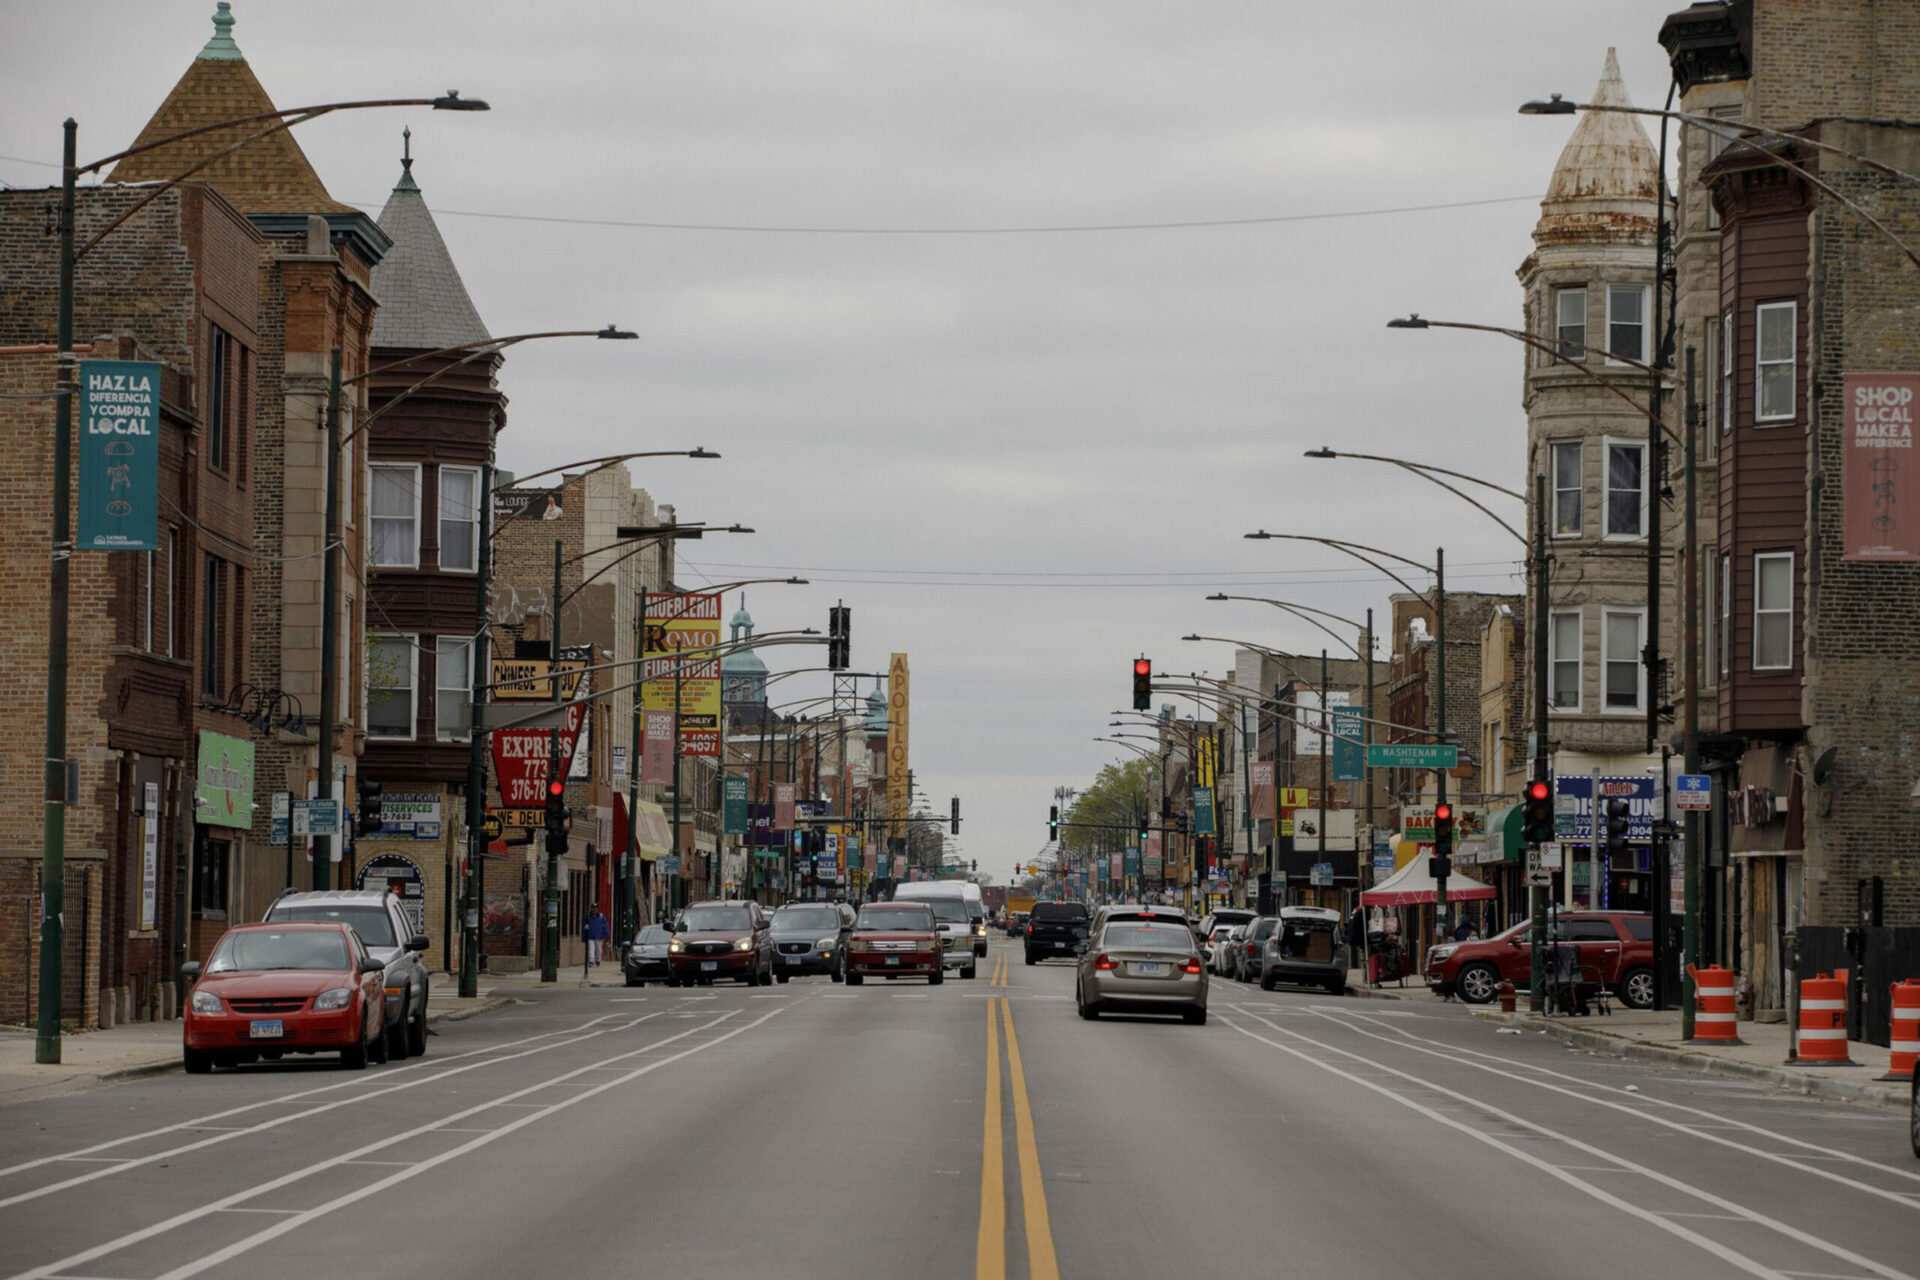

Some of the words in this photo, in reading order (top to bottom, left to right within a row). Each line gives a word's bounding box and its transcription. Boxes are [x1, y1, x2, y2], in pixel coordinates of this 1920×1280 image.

[89, 375, 125, 391] HAZ
[129, 376, 151, 391] LA
[89, 392, 151, 404] DIFERENCIA
[1855, 386, 1912, 406] SHOP
[90, 405, 98, 415] Y
[99, 405, 151, 417] COMPRA
[1855, 407, 1912, 422] LOCAL
[88, 417, 151, 435] LOCAL
[1856, 424, 1899, 437] MAKE
[1901, 424, 1912, 437] A
[1855, 438, 1912, 448] DIFFERENCE
[644, 597, 718, 619] MUEBLERIA
[643, 624, 716, 652] ROMO
[494, 665, 536, 691] CHINESE
[547, 666, 574, 691] FOD
[502, 736, 572, 758] EXPRES
[523, 760, 548, 778] 773
[511, 779, 546, 800] 376-78
[1575, 798, 1655, 816] ISCUN
[497, 810, 512, 824] WE
[519, 810, 546, 824] DELI
[1406, 817, 1458, 827] BAKY
[1394, 889, 1466, 904] AVN
